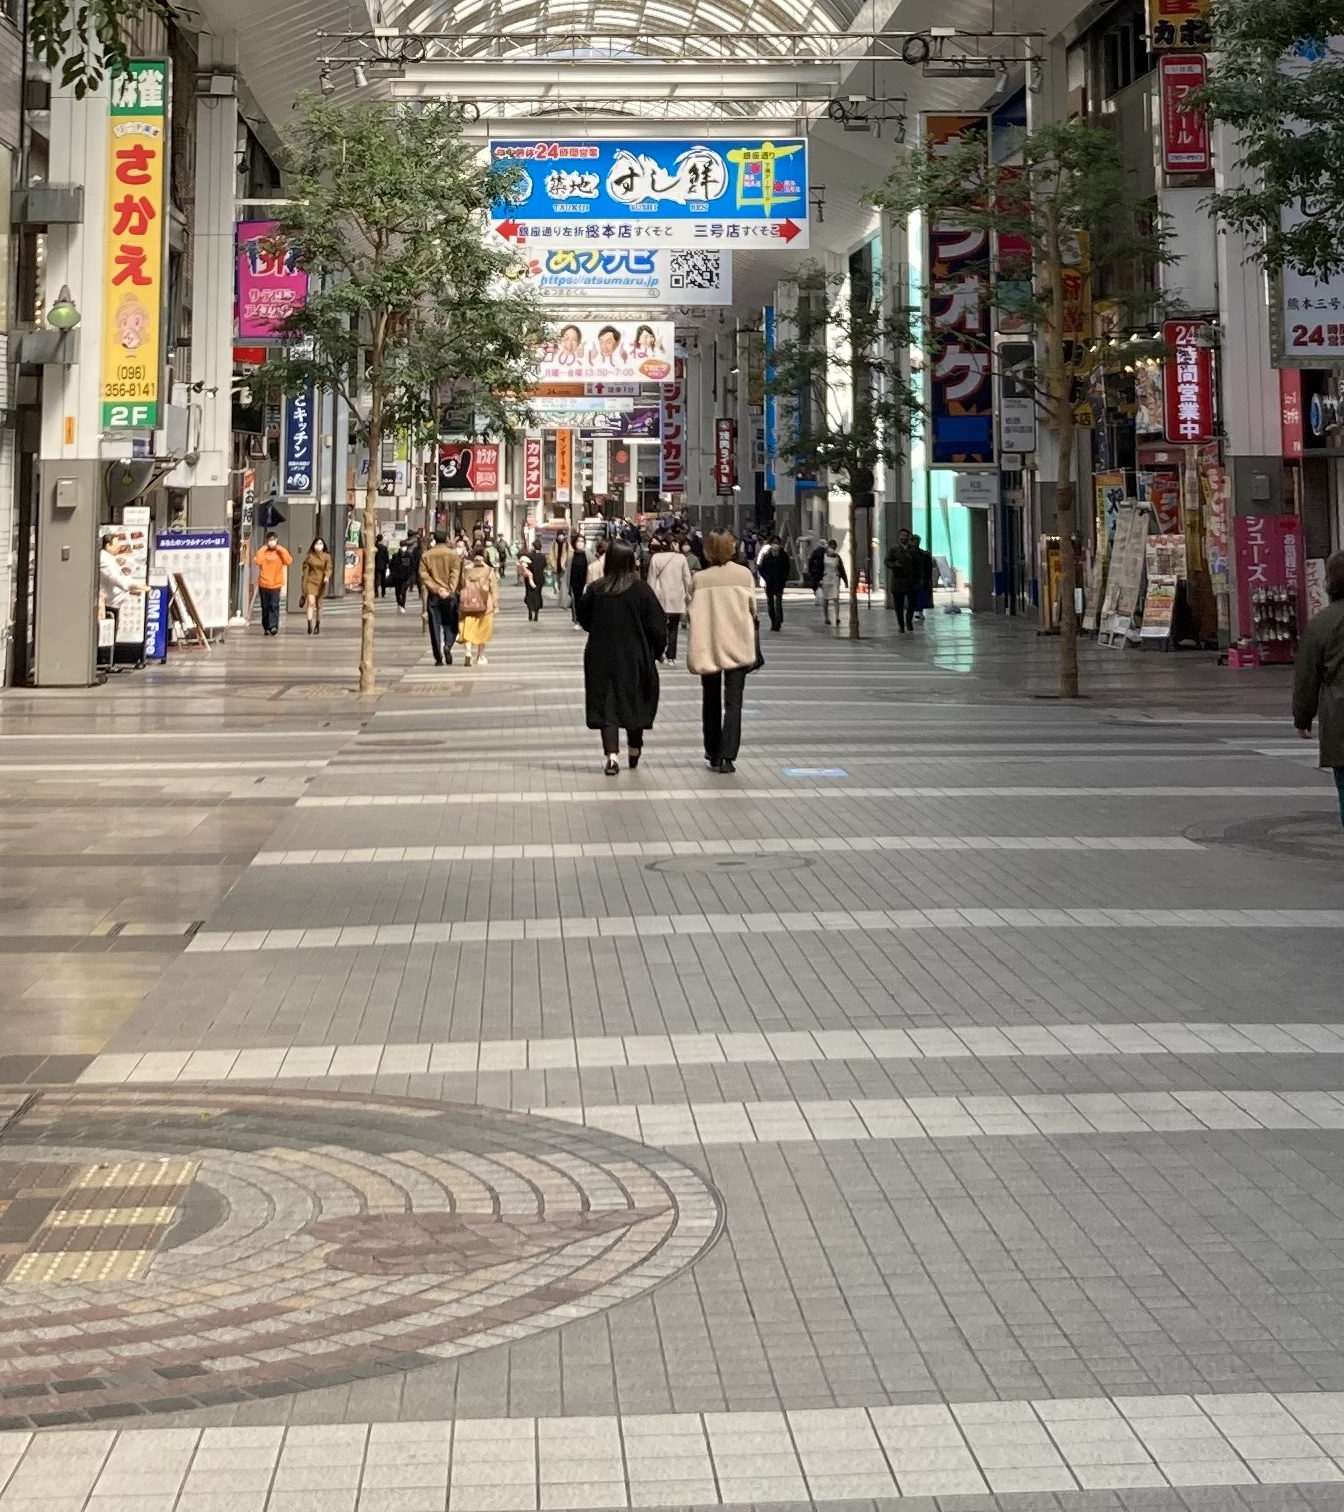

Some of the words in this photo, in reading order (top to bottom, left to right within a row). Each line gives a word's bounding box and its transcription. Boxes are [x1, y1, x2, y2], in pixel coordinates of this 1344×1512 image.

[549, 173, 594, 196] 築地
[613, 159, 721, 201] すし鮮
[112, 143, 157, 287] さかえ
[541, 275, 660, 288] https://atsumaru.jp
[1291, 324, 1325, 347] 24
[116, 364, 147, 381] (096)
[104, 382, 157, 400] 356-8141
[109, 406, 150, 427] 2F
[526, 441, 541, 495] カラオケ
[1246, 515, 1268, 583] シューズ
[148, 588, 162, 620] SIM
[145, 621, 160, 655] Free
